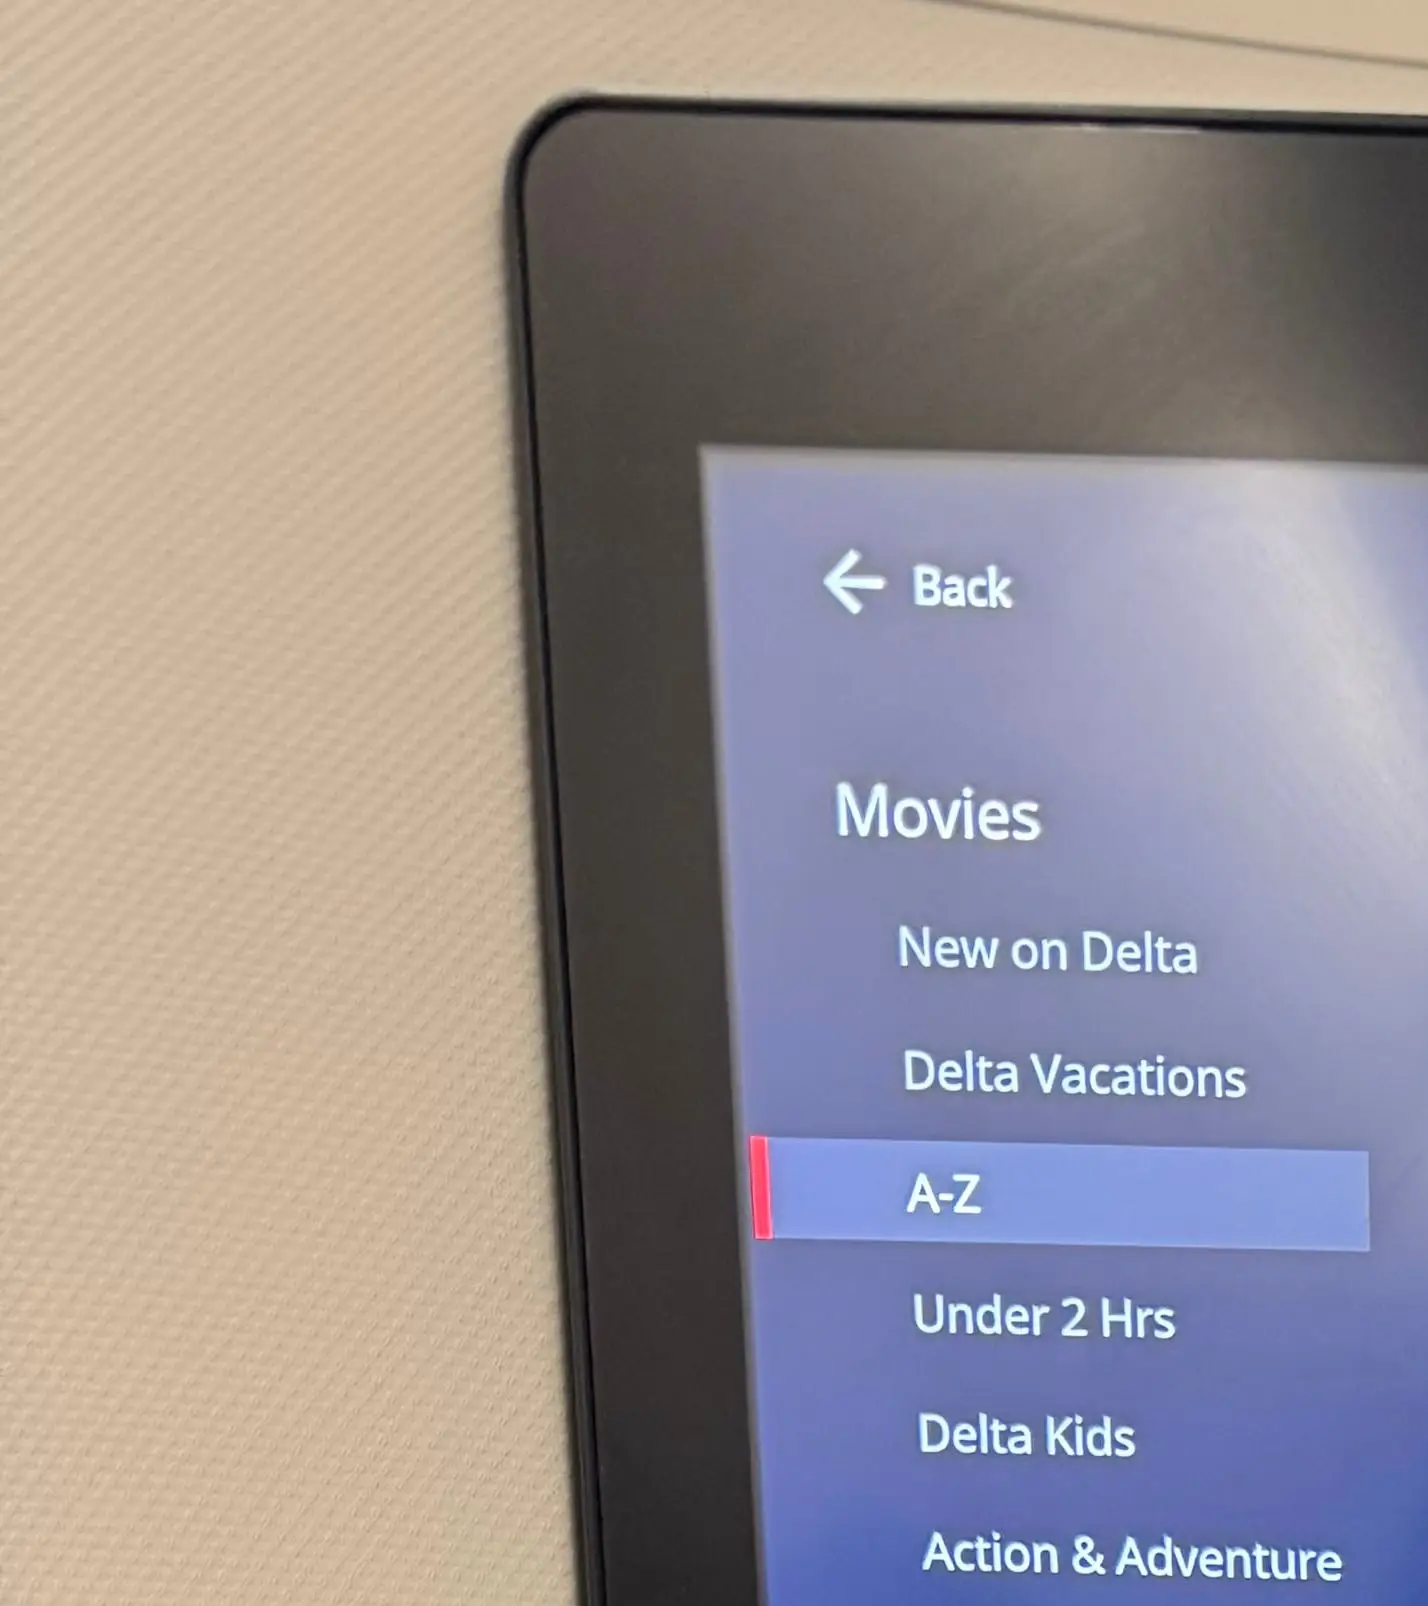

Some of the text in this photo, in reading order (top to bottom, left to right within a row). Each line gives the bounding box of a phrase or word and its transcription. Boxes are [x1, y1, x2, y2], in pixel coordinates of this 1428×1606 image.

[914, 564, 1013, 608] Back
[837, 782, 1041, 840] Movies
[900, 926, 1197, 973] New on Delta
[905, 1050, 1246, 1097] Delta Vacations
[907, 1173, 981, 1213] A-Z
[914, 1294, 1175, 1338] Under 2 Hrs
[920, 1413, 1135, 1457] Delta Kids
[923, 1531, 1342, 1581] Action & Adventure
